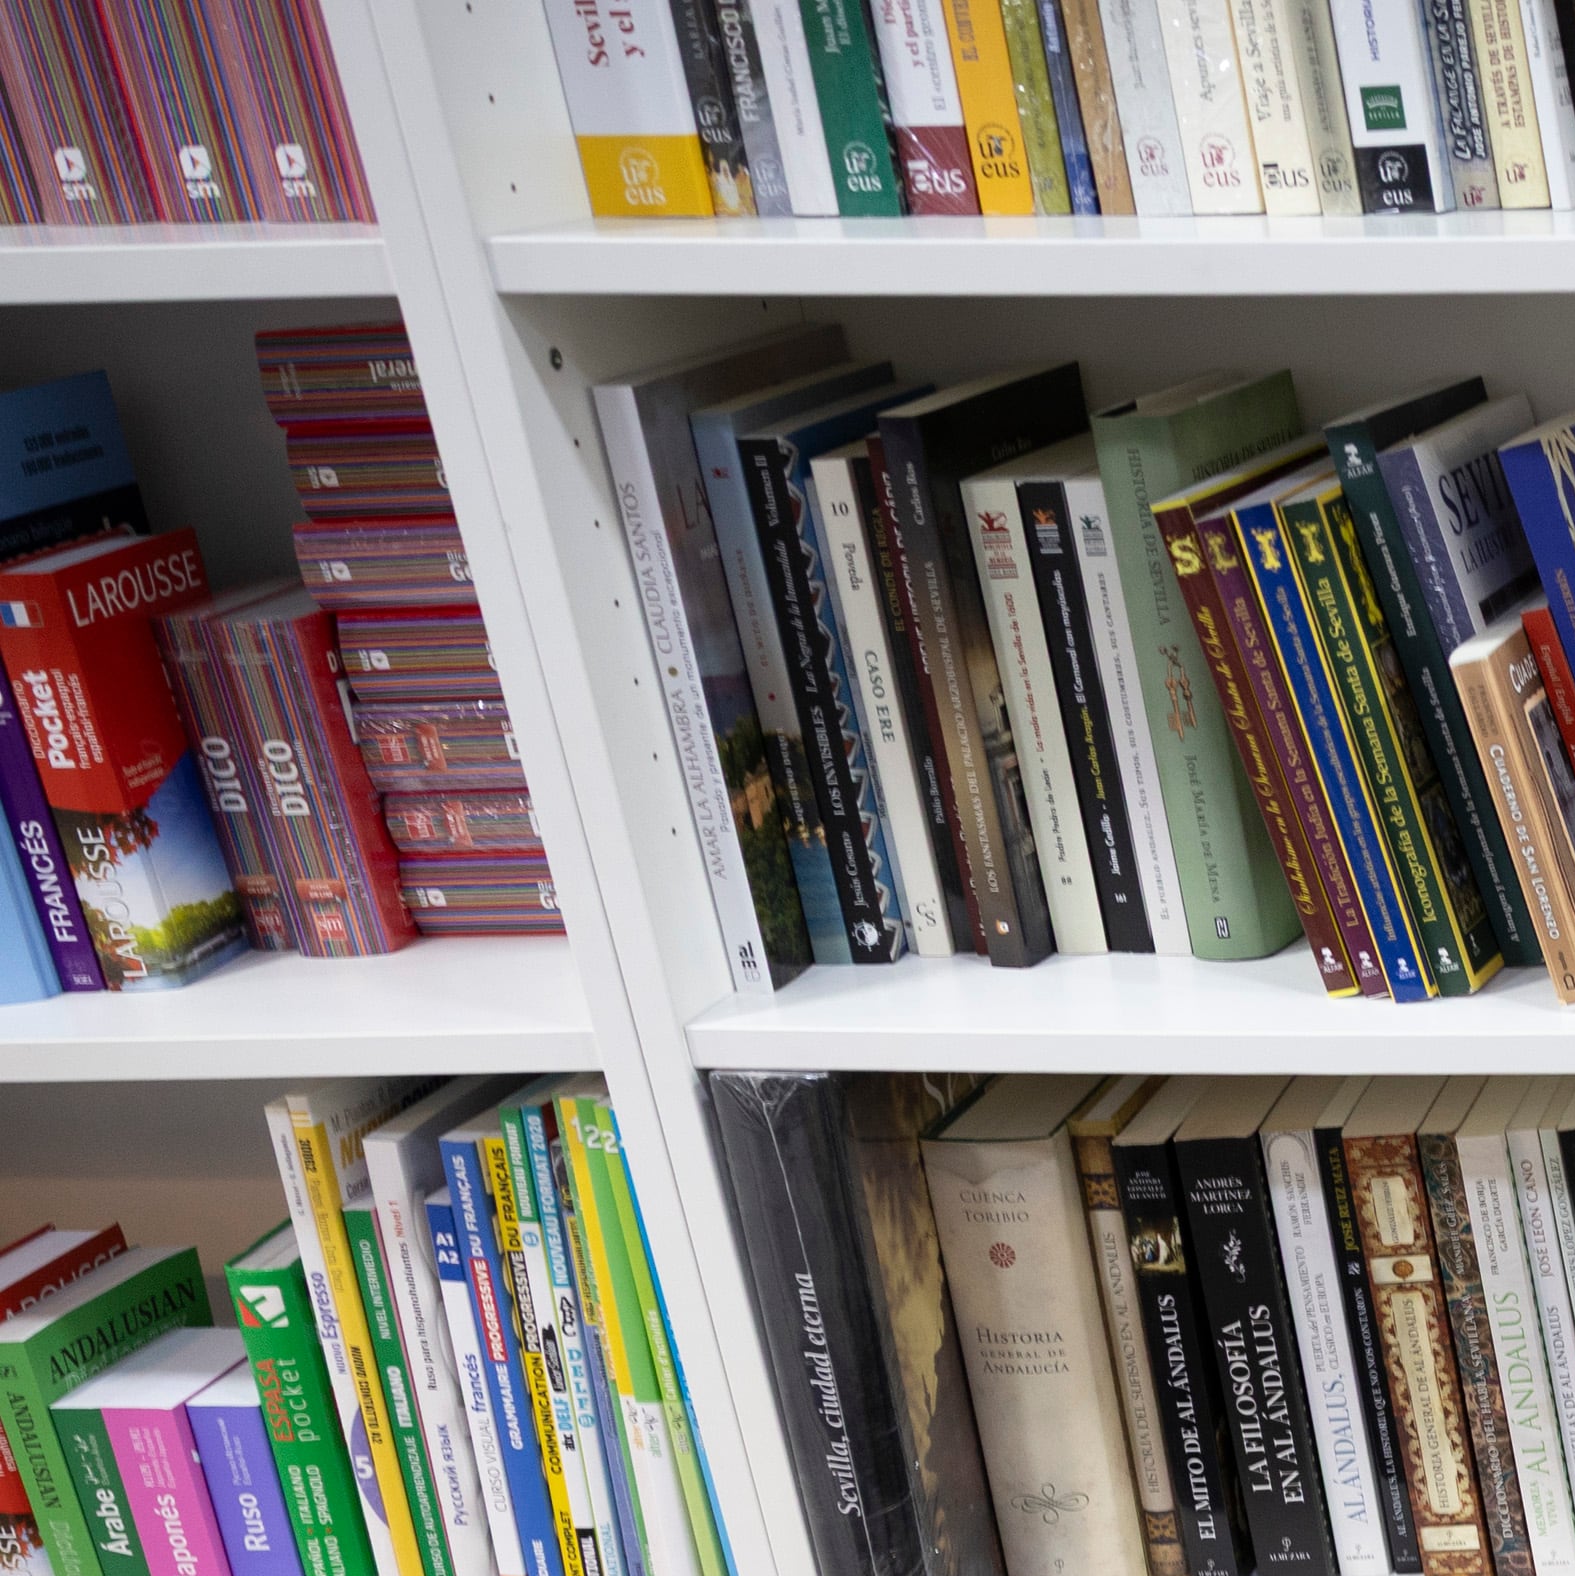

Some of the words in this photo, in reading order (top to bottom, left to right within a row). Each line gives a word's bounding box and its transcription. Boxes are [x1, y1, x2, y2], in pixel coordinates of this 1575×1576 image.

[64, 548, 201, 630] LAROUSSE
[45, 669, 76, 772] Pocket
[202, 736, 247, 814] DICO
[261, 738, 311, 818] DICO
[1489, 744, 1522, 822] CUADERNO
[1515, 825, 1530, 843] DE
[1522, 843, 1539, 874] SAN
[26, 817, 80, 945] FRANCÉS
[76, 826, 148, 981] LAROUSSE
[1531, 873, 1560, 940] LORENZO
[451, 1154, 478, 1229] FRANÇAIS
[959, 1189, 1027, 1206] CUENCA
[962, 1208, 1031, 1225] TORIBIO
[1190, 1188, 1254, 1204] MARTÍNEZ
[1194, 1176, 1244, 1191] ANDRÉS
[1202, 1201, 1244, 1214] LORCA
[471, 1234, 484, 1257] DU
[46, 1279, 197, 1383] ANDALUSIAN
[472, 1258, 508, 1361] PROGRESSIVE
[795, 1271, 828, 1349] eterna
[976, 1327, 1064, 1346] HISTORIA
[1158, 1294, 1191, 1393] ÁNDALUS
[809, 1346, 848, 1428] ciudad
[981, 1359, 1071, 1377] ANDALUCÍA
[1217, 1320, 1267, 1455] FILOSOFÍA
[1249, 1304, 1290, 1426] ÁNDALUS
[1493, 1289, 1541, 1433] ÁNDALUS
[262, 1357, 296, 1443] ESPASA
[280, 1356, 321, 1443] pocket
[495, 1363, 524, 1452] GRAMMAIRE
[1177, 1397, 1197, 1425] AL
[824, 1428, 864, 1517] Sevilla,
[1181, 1425, 1201, 1454] DE
[1274, 1430, 1297, 1464] AL
[1524, 1438, 1551, 1477] AL
[1188, 1457, 1212, 1512] MITO
[1249, 1459, 1273, 1493] LA
[1278, 1470, 1305, 1504] EN
[96, 1487, 134, 1557] Árabe
[242, 1491, 272, 1554] Ruso
[1197, 1515, 1217, 1541] EL
